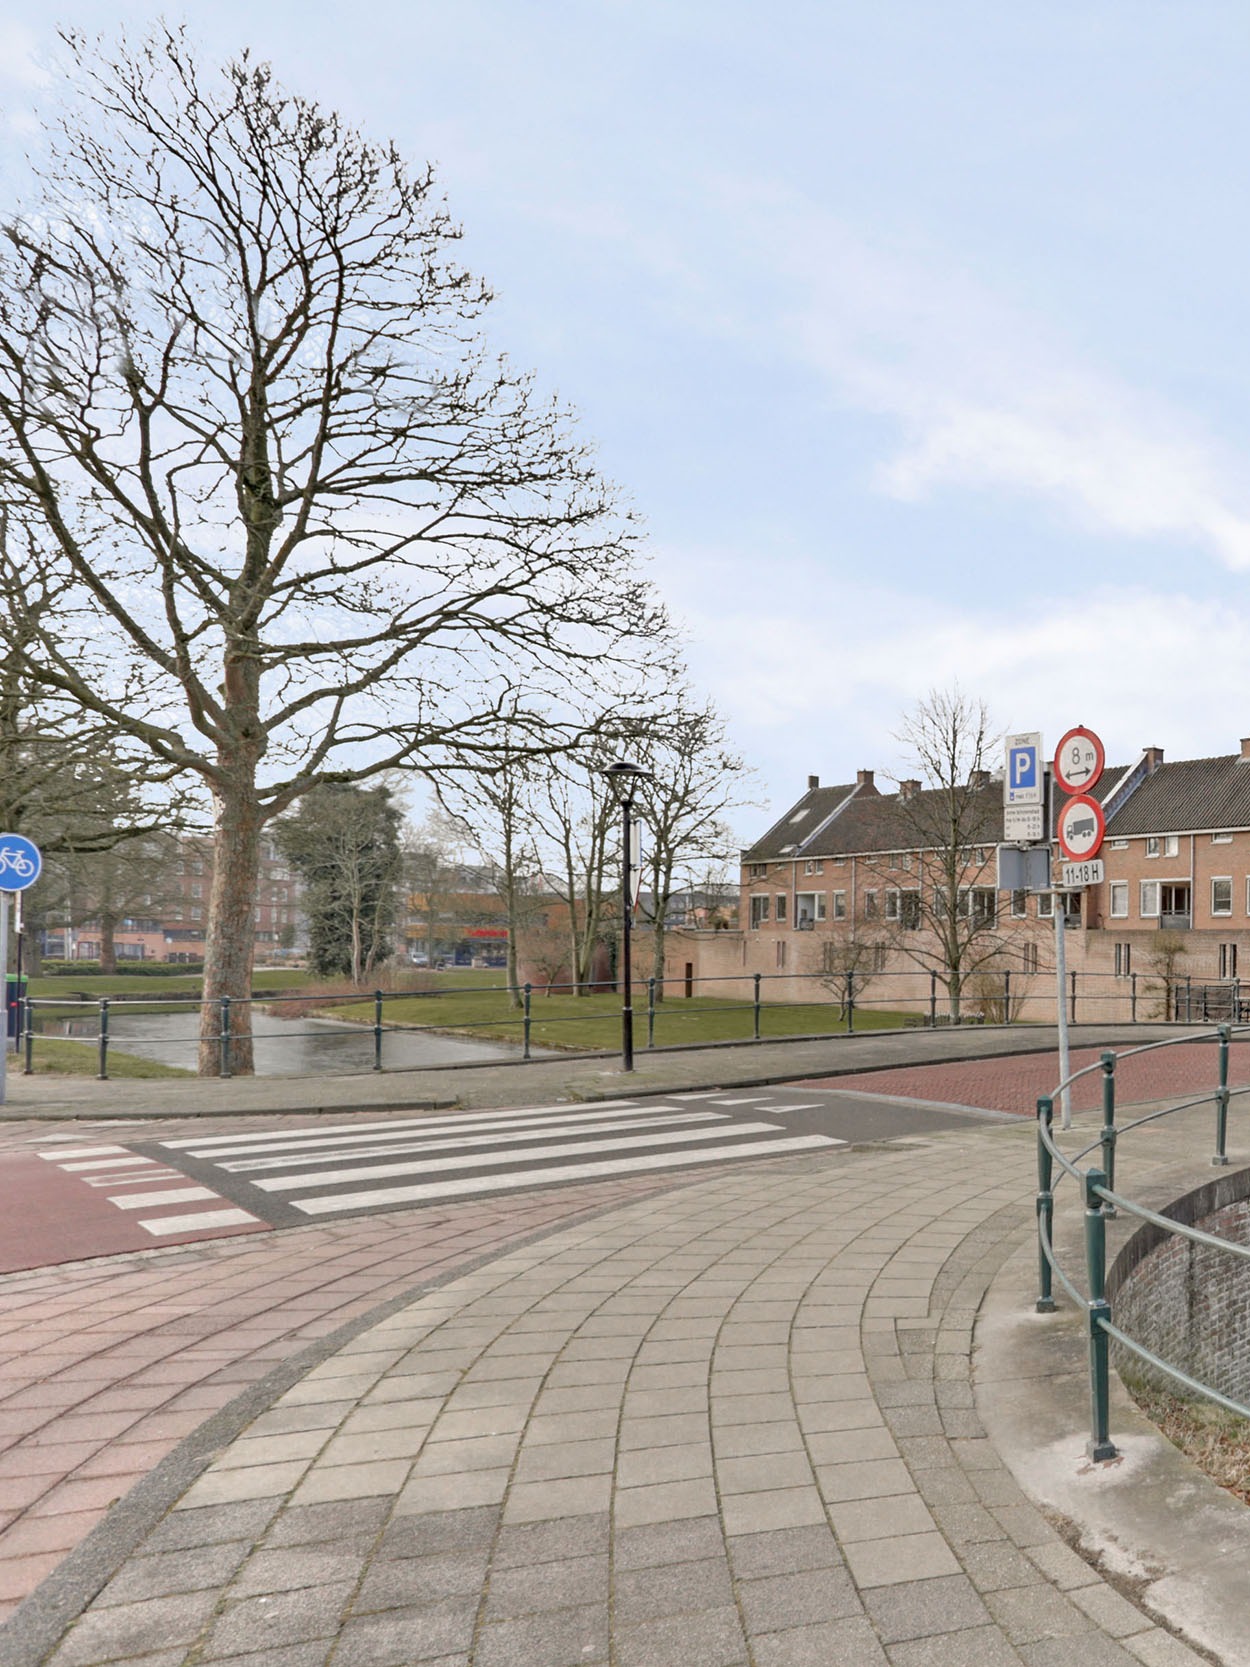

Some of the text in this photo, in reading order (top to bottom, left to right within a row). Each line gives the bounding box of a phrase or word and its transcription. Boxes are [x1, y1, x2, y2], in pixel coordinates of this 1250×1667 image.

[1071, 747, 1094, 765] 8 m
[1016, 752, 1031, 785] P
[1065, 864, 1100, 885] 11-18 H
